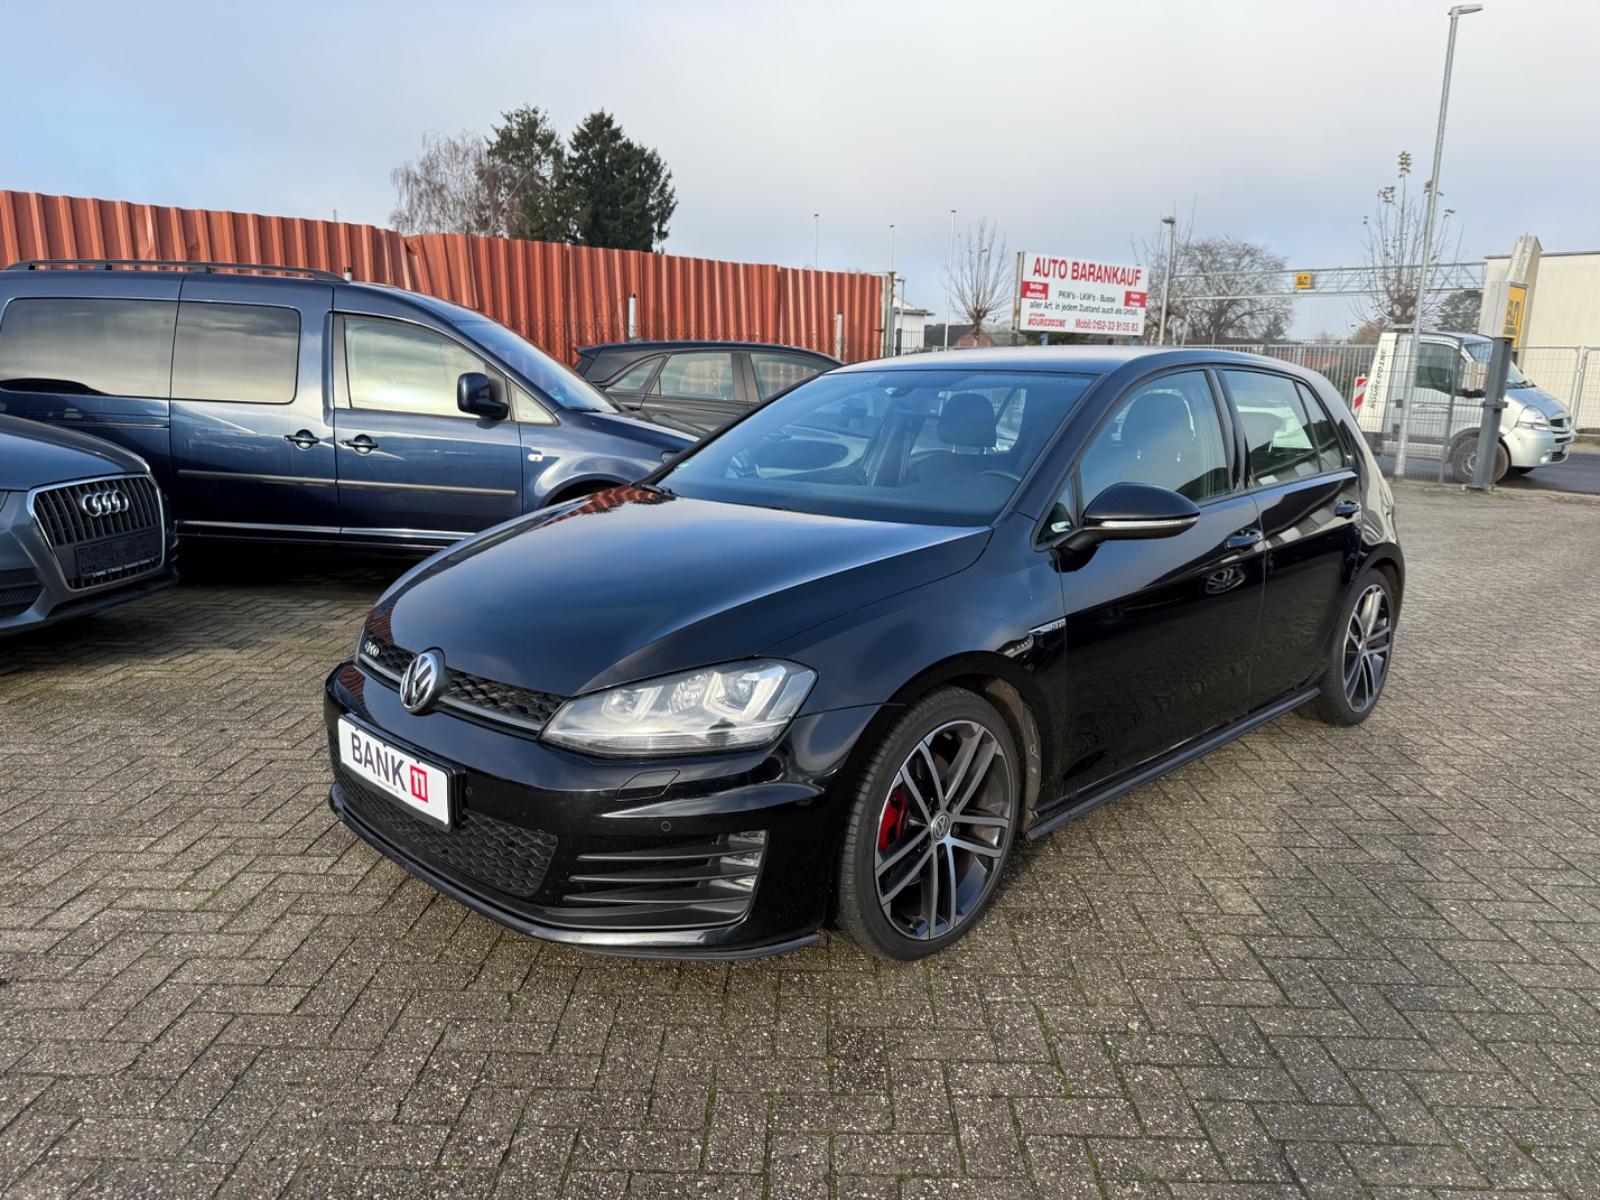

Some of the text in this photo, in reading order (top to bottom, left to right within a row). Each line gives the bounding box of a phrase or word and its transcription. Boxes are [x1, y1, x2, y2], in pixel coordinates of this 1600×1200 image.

[1033, 257, 1141, 286] AUTO BARANKAUF
[351, 731, 407, 792] BANK
